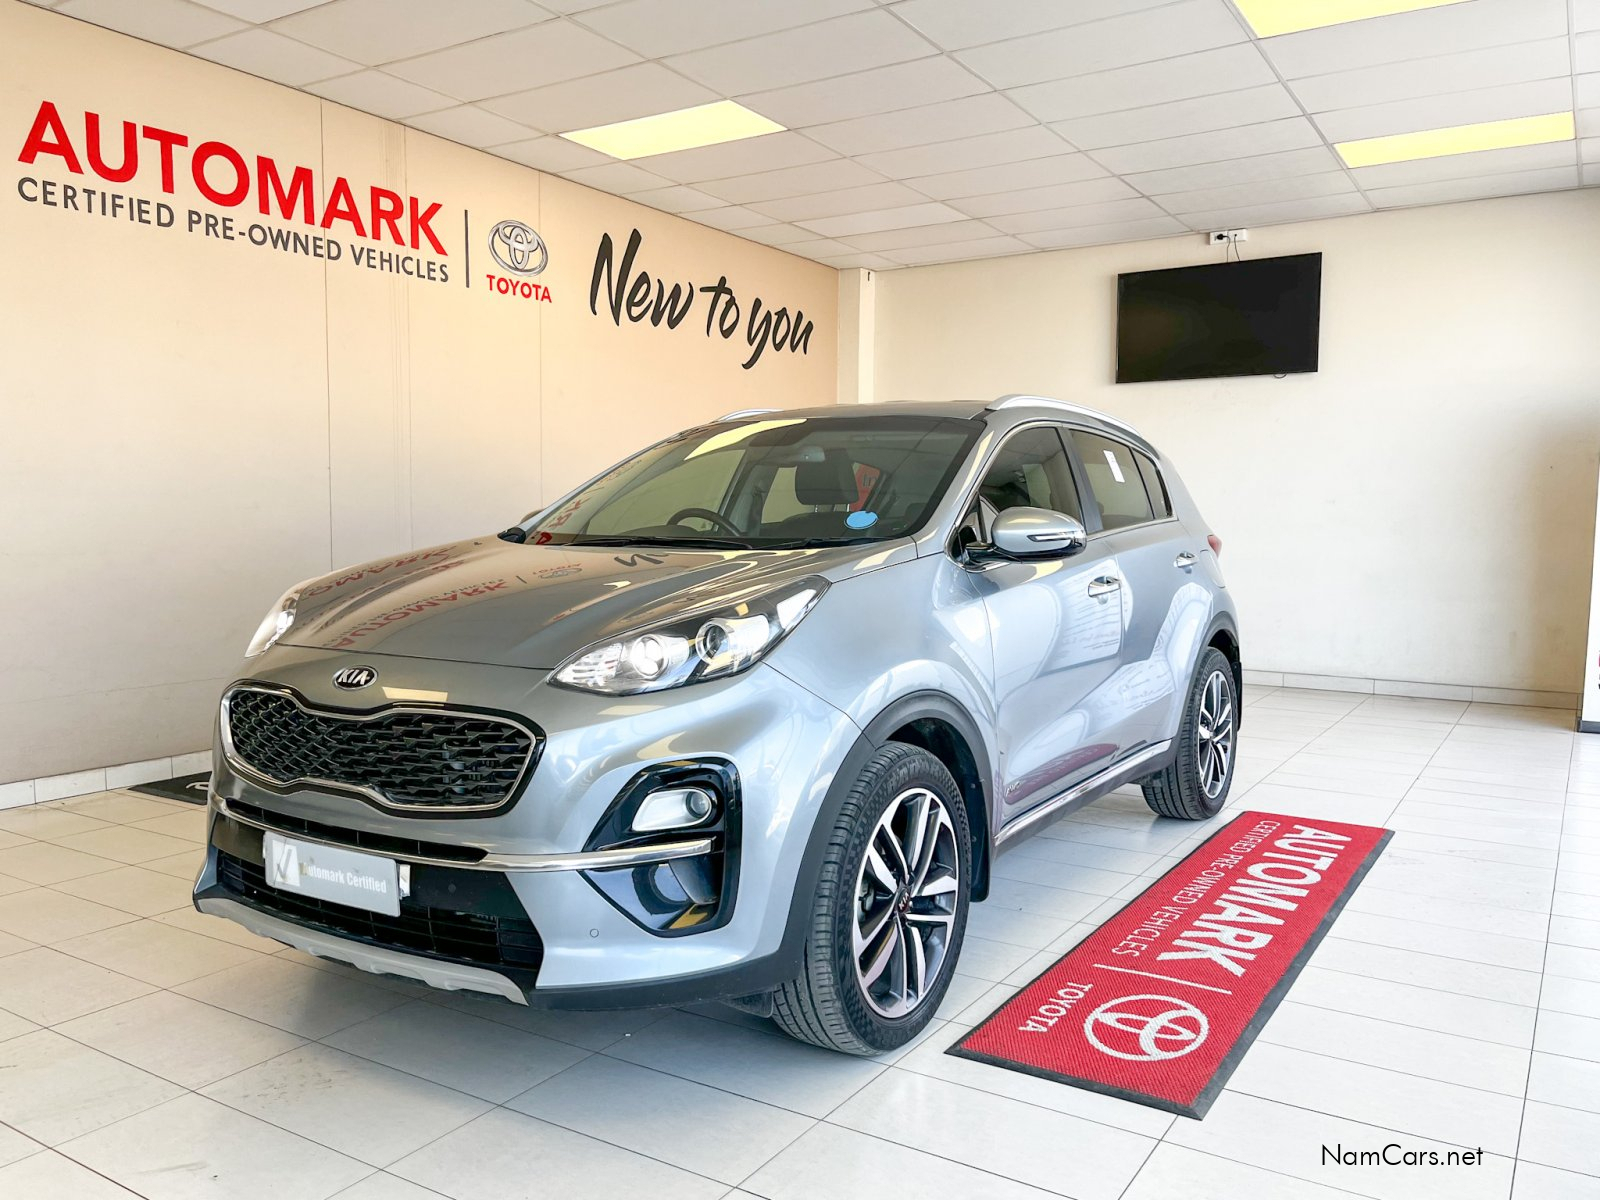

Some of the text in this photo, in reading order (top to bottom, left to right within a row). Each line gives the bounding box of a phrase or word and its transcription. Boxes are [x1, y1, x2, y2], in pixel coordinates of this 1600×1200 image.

[17, 177, 449, 283] CERTIFIED PRE-OWNED VEHICLES
[18, 101, 448, 256] AUTOMARK
[486, 274, 552, 304] TOYOTA
[589, 228, 814, 370] New to you
[337, 669, 370, 685] KIA
[346, 872, 387, 893] Certified
[1111, 820, 1281, 957] CERTIFIED PRE-OWNED VEHICLES
[1156, 824, 1352, 978] AUTOMARK
[1018, 981, 1094, 1034] TOYOTA
